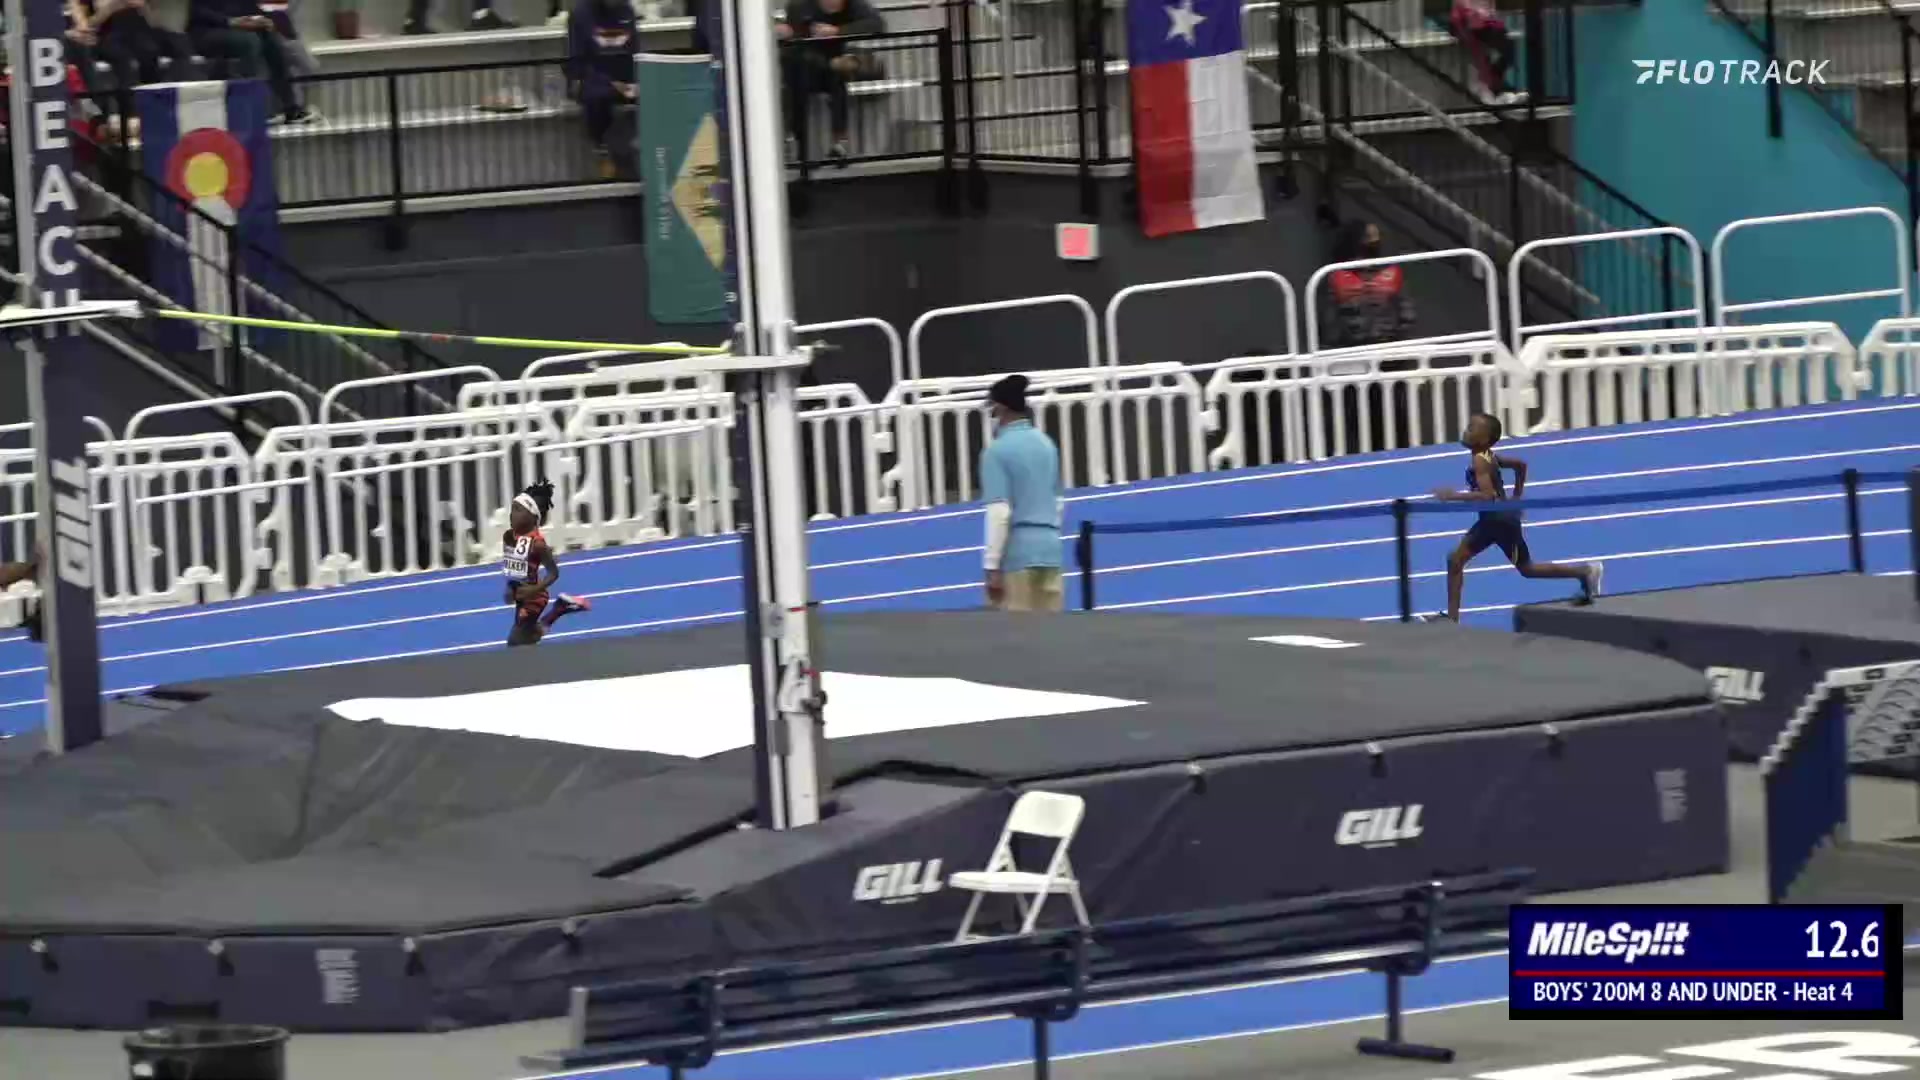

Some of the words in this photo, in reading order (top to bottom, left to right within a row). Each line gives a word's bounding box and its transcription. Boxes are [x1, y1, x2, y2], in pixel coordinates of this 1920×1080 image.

[28, 37, 80, 339] BEACH
[50, 456, 94, 589] GILL
[516, 537, 528, 556] 3
[1334, 803, 1424, 845] GILL
[852, 857, 944, 900] GILL
